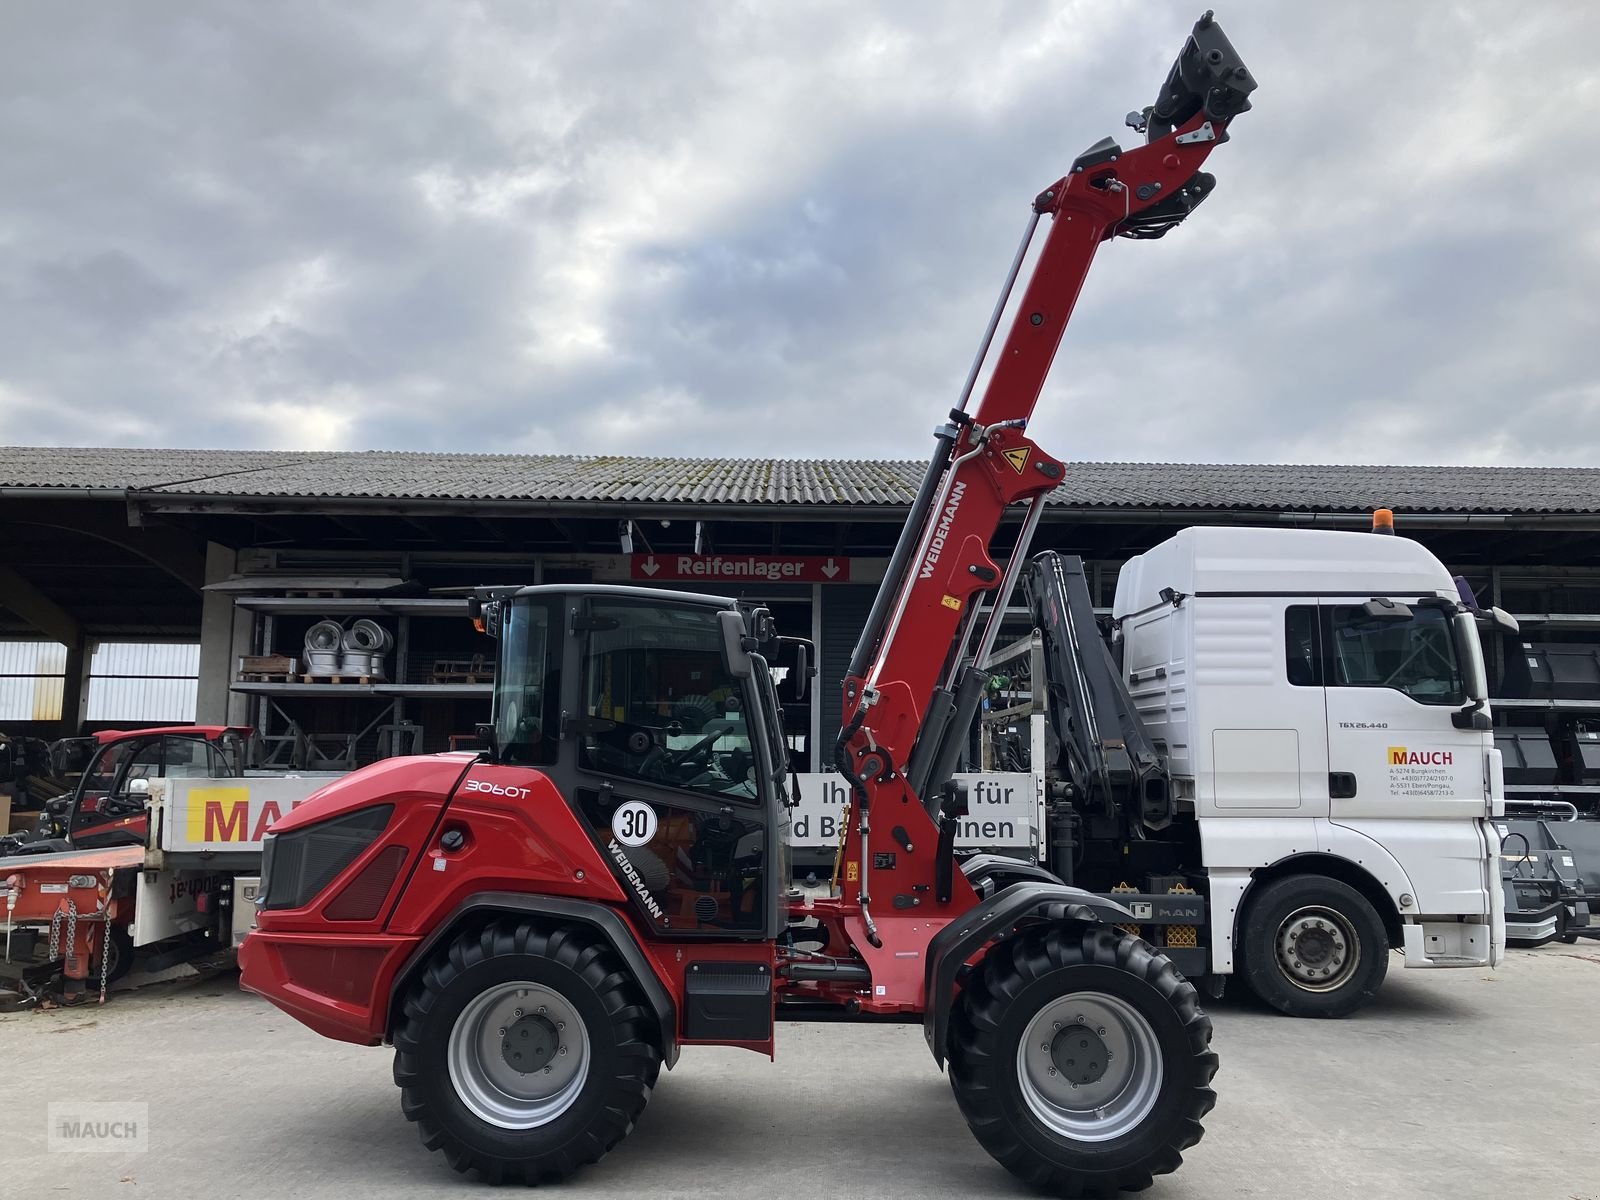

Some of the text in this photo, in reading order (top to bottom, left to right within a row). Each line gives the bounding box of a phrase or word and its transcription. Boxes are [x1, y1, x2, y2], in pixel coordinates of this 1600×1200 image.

[920, 481, 967, 579] WEIDEMANN
[677, 556, 805, 580] Reifenlager
[1393, 751, 1453, 765] MAUCH
[465, 780, 531, 800] 3060T
[974, 781, 1014, 805] für
[204, 800, 302, 842] MA
[621, 809, 648, 838] 30
[607, 838, 663, 919] WEIDEMANN
[1159, 908, 1199, 917] MAN
